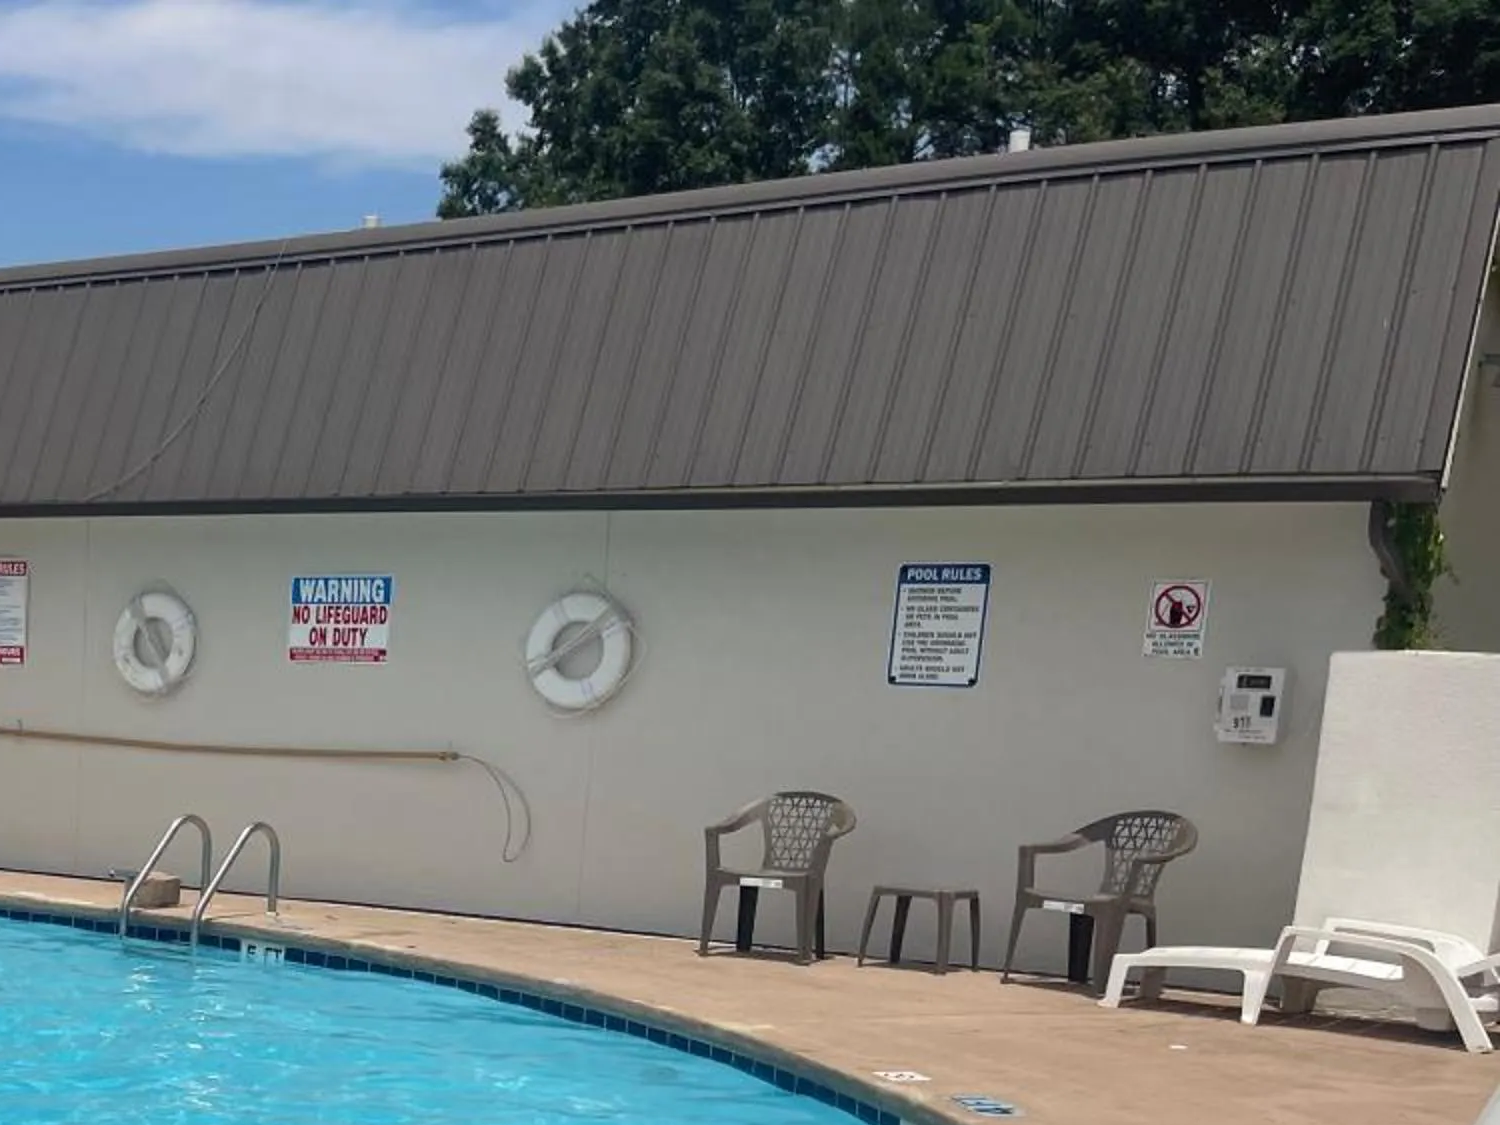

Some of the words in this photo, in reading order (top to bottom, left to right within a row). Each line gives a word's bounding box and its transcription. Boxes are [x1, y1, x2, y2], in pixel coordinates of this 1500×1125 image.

[907, 567, 938, 580] POOL
[940, 567, 982, 580] RULES
[300, 579, 385, 603] WARNING
[291, 605, 311, 624] NO
[315, 605, 388, 624] LIFEGUARD
[309, 627, 327, 646] ON
[333, 627, 369, 646] DUTY
